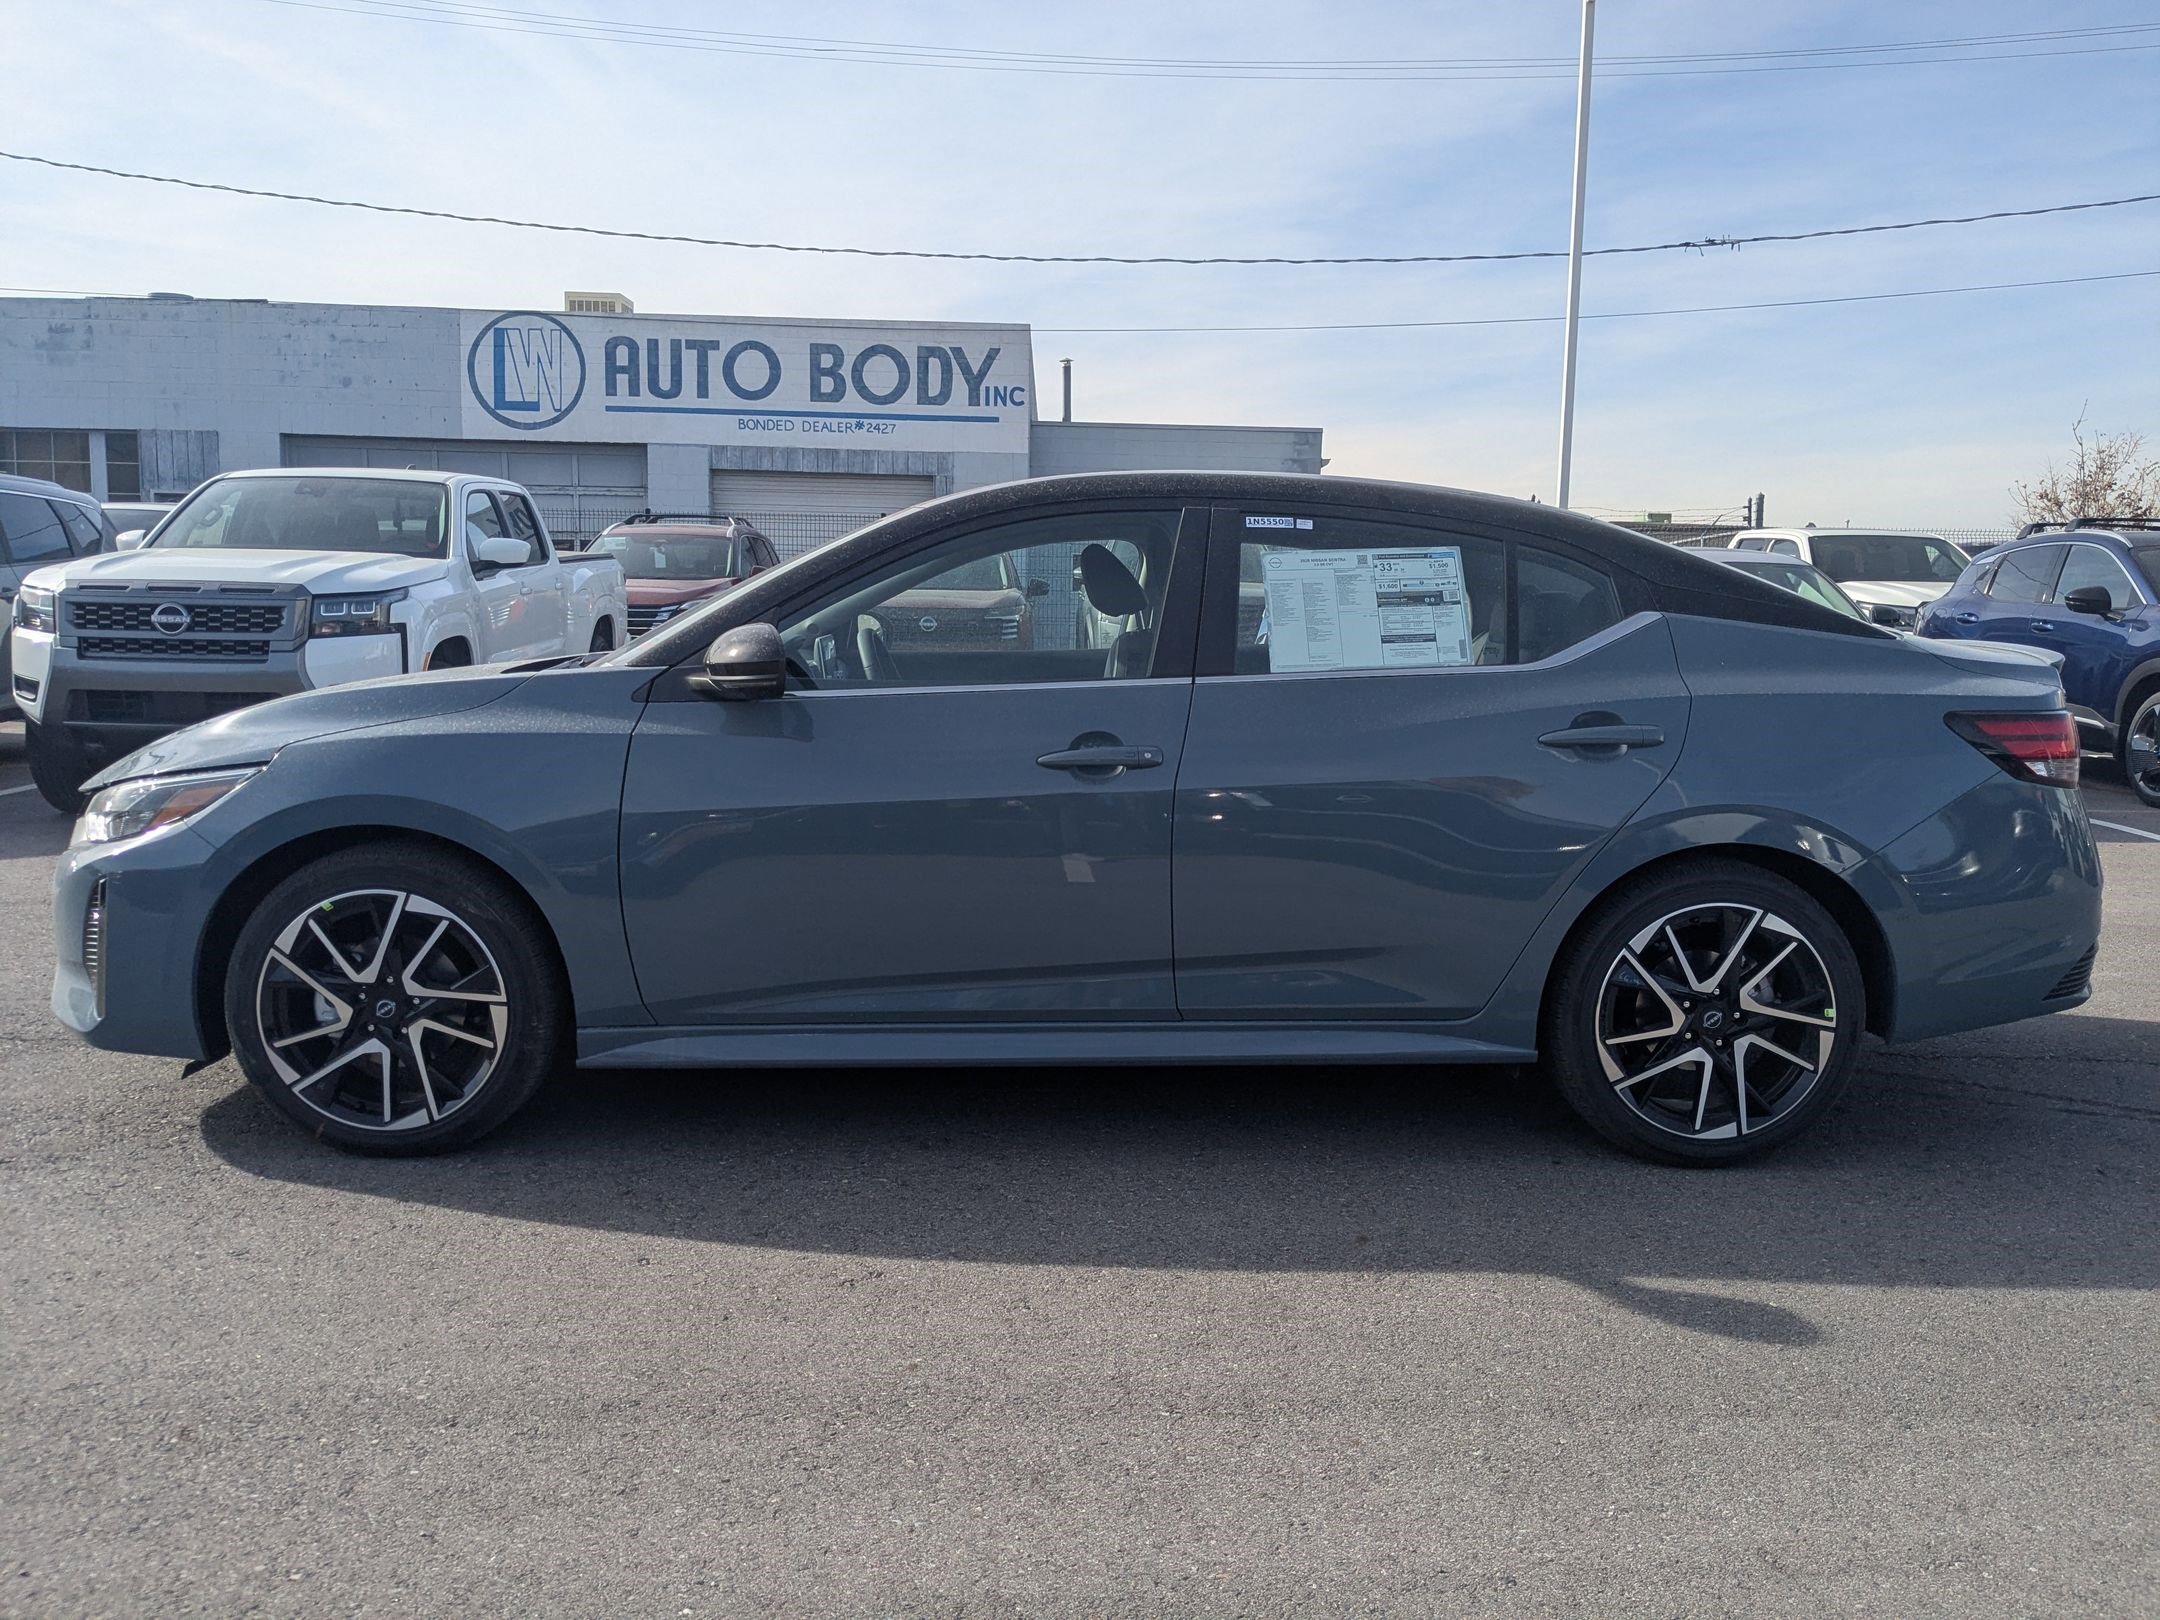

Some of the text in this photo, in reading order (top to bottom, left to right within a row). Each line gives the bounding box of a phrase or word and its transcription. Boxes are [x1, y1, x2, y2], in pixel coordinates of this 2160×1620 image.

[605, 336, 1025, 408] AUTO BODY INC
[738, 418, 795, 432] BONDED
[1379, 562, 1393, 572] 33
